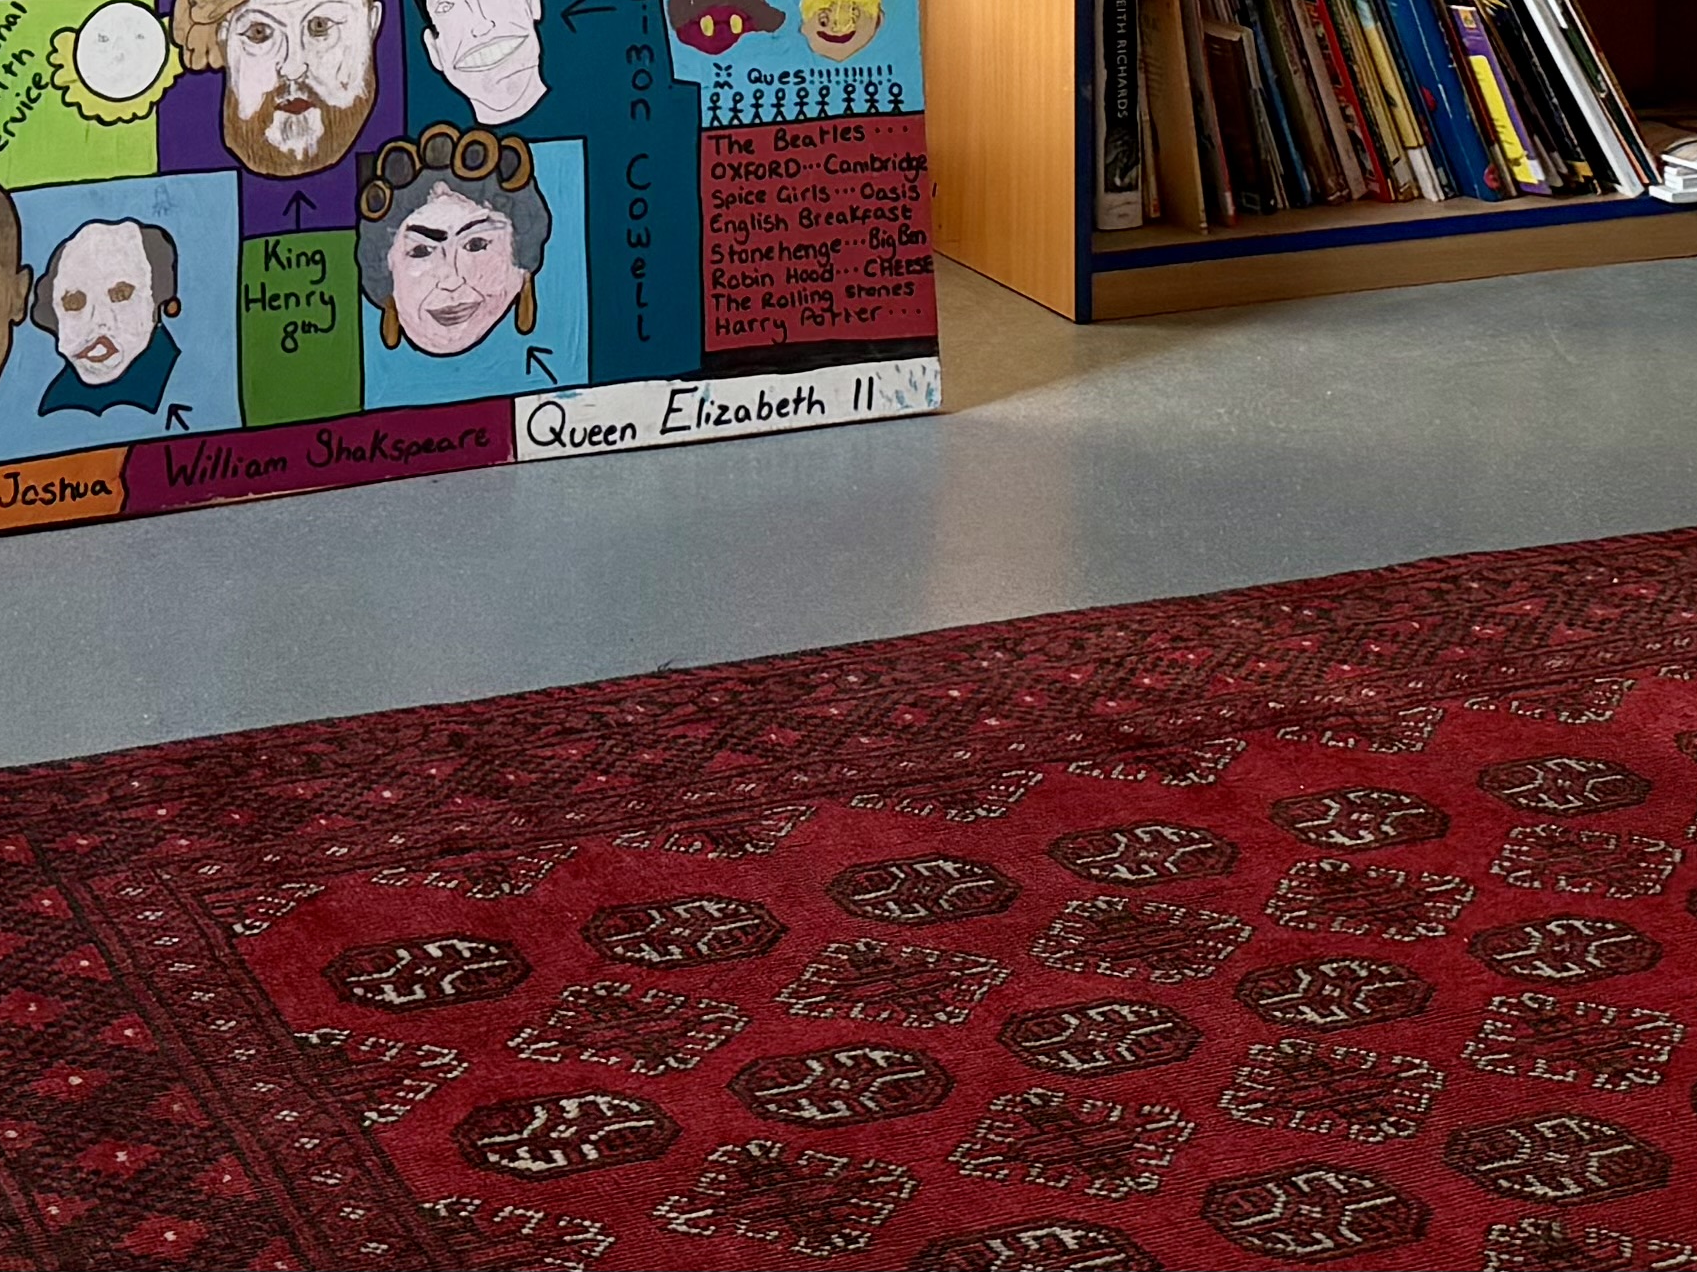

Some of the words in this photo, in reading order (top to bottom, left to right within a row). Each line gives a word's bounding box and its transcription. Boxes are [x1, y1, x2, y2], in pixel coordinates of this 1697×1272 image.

[1117, 39, 1129, 119] RICHARDS
[710, 135, 755, 157] The
[711, 188, 767, 211] Spice
[709, 216, 789, 244] English
[263, 239, 327, 275] King
[711, 270, 776, 292] Robin
[711, 293, 757, 313] The
[714, 313, 787, 347] Harry
[526, 401, 638, 450] Queen
[659, 385, 826, 437] Elizabeth
[163, 443, 288, 490] William
